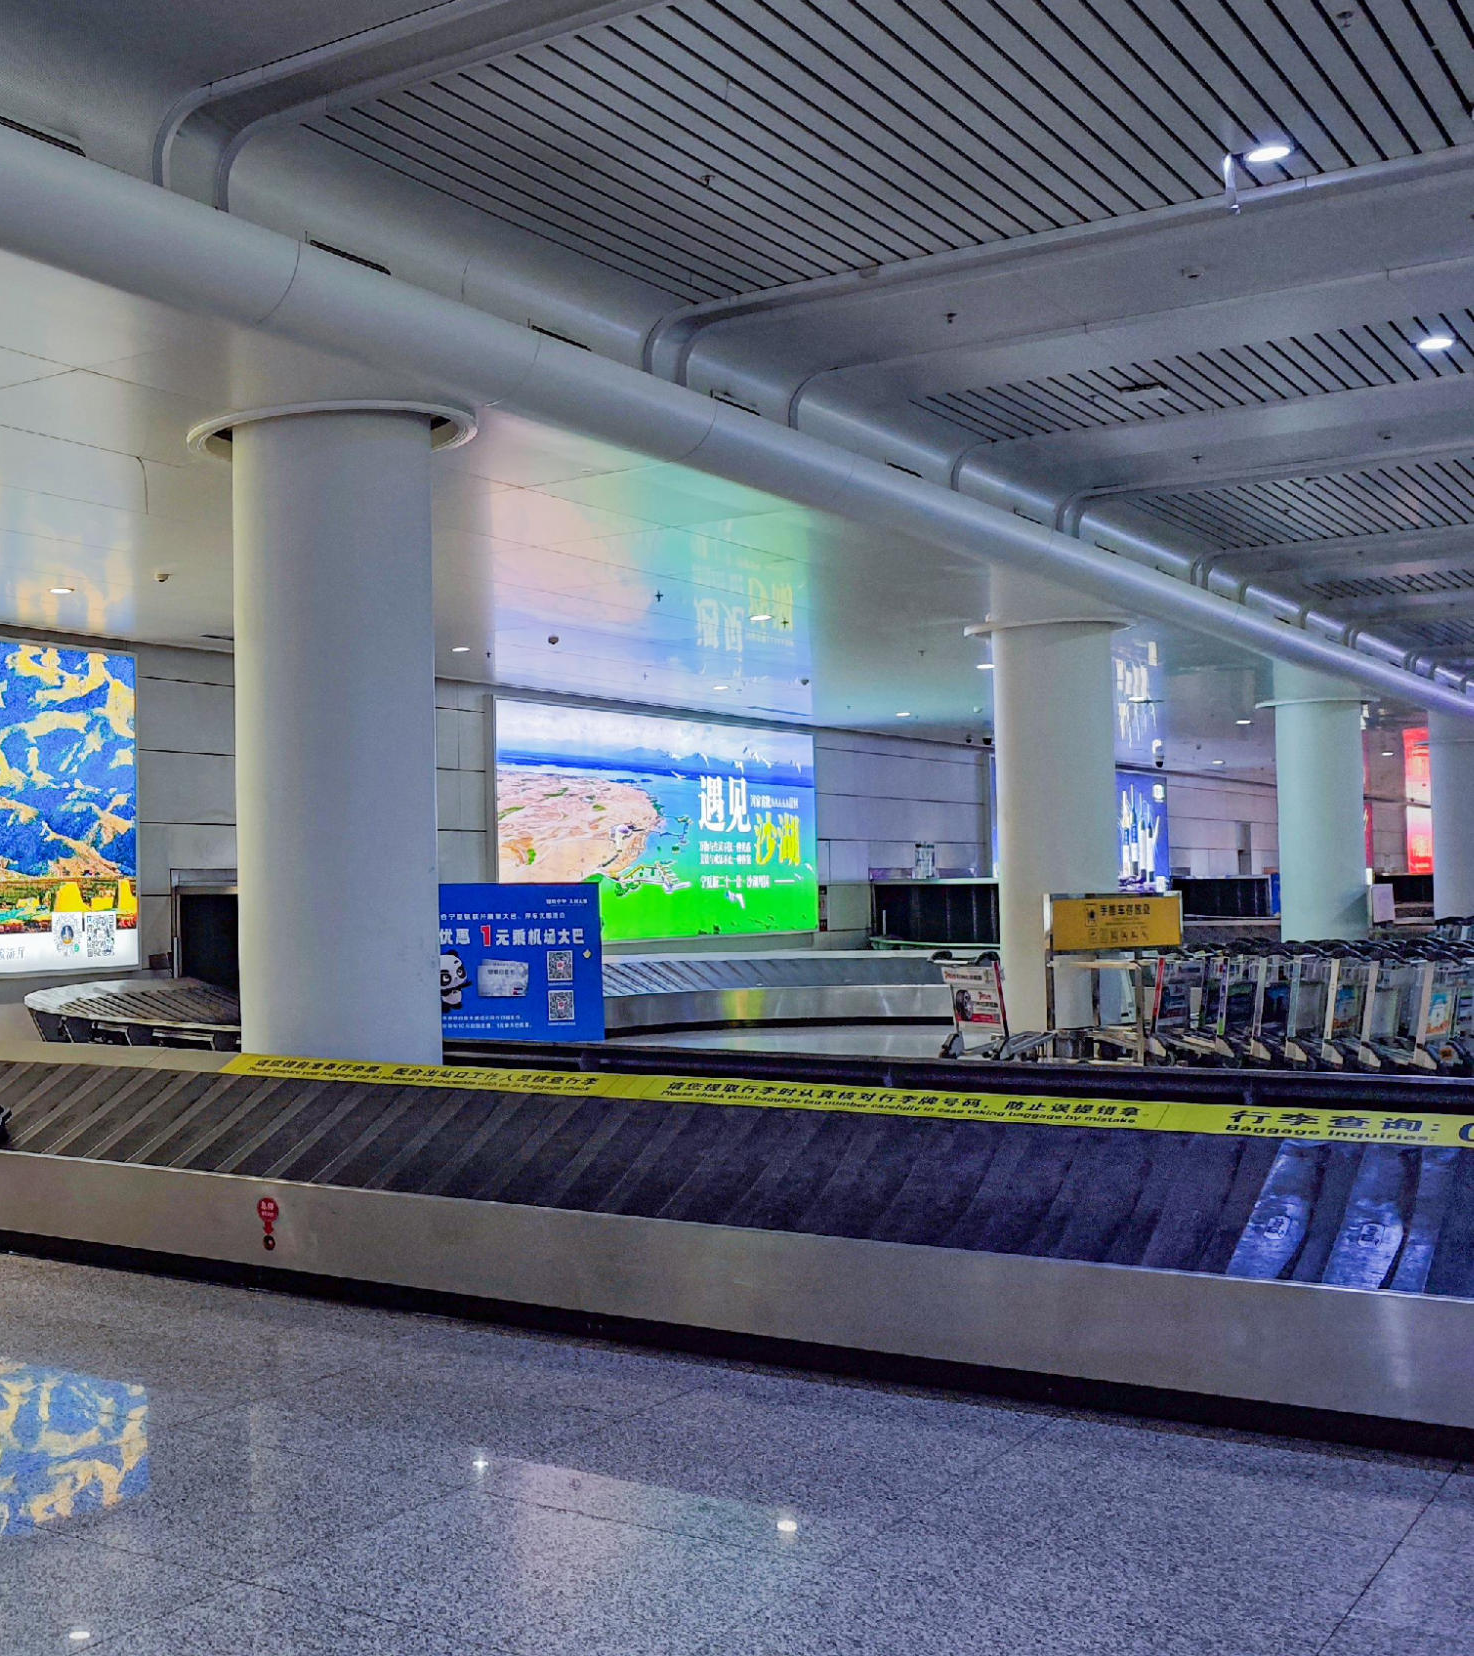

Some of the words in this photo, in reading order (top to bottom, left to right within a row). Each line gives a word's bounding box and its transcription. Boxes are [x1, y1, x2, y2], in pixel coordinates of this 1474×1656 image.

[698, 775, 752, 834] 遇见
[753, 810, 802, 867] 沙湖
[440, 928, 471, 945] 优惠
[660, 1090, 694, 1098] Please
[695, 1091, 725, 1100] check
[727, 1094, 752, 1102] your
[754, 1095, 801, 1105] baggage
[824, 1099, 868, 1109] number
[870, 1102, 920, 1112] carefully
[937, 1107, 964, 1115] case
[967, 1108, 1004, 1118] taking
[1008, 1111, 1064, 1121] baggage
[1084, 1114, 1137, 1124] mistake
[1225, 1123, 1321, 1137] Baggage
